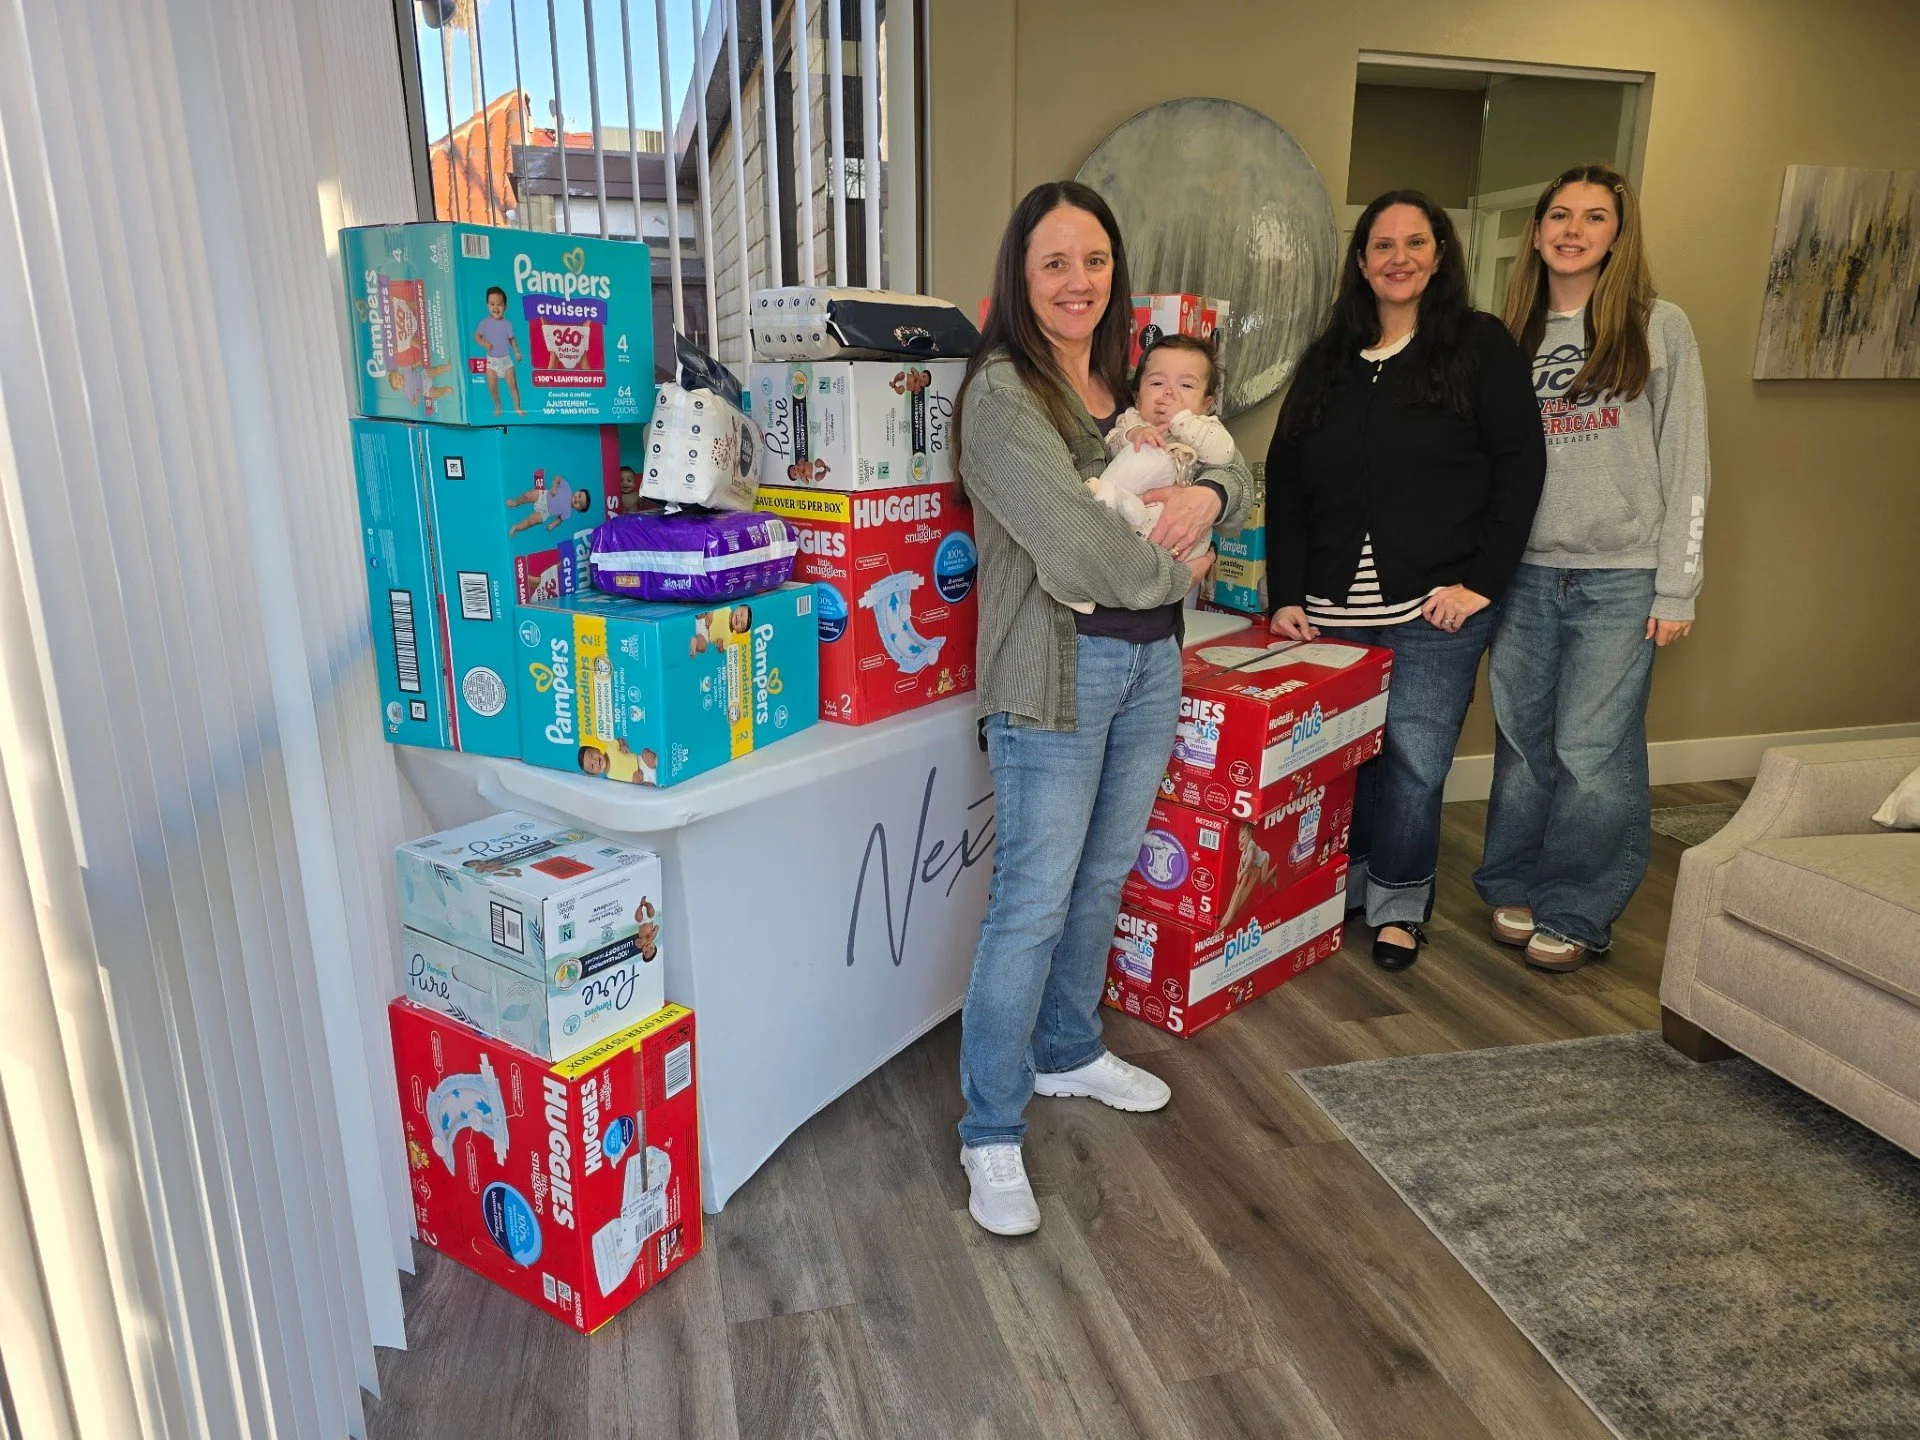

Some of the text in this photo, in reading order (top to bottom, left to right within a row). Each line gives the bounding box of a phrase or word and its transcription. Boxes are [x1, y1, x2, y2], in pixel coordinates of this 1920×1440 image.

[392, 248, 402, 263] 4
[429, 243, 437, 263] 64
[514, 254, 610, 301] Pampers
[537, 302, 598, 318] cruisers
[366, 270, 386, 378] Pampers
[382, 287, 393, 357] cruisers
[616, 334, 628, 352] 4
[618, 386, 631, 397] 64
[612, 406, 638, 414] COUCHES
[614, 398, 636, 406] DIAPERS
[1542, 398, 1577, 414] ALL
[765, 398, 789, 460] Pure
[930, 391, 953, 453] Pure
[1542, 406, 1620, 435] ERICAN
[1548, 433, 1598, 445] RLEADER
[756, 496, 773, 506] SAVE
[774, 498, 795, 509] OVER
[807, 501, 823, 511] PER
[854, 492, 941, 529] HUGGIES
[905, 529, 941, 543] snugglers
[917, 523, 928, 531] little
[791, 526, 846, 557] GIES
[1219, 537, 1247, 556] Pampers
[947, 549, 964, 560] 100%
[806, 564, 847, 578] snugglers
[617, 577, 639, 586] 3T-4T
[1243, 591, 1248, 601] 5
[581, 634, 593, 645] 2
[621, 639, 628, 652] 84
[753, 623, 774, 725] Pampers
[545, 638, 574, 745] Pampers
[580, 656, 592, 736] swaddlers
[620, 694, 625, 702] de
[824, 700, 837, 710] 144
[841, 694, 851, 713] 2
[1180, 696, 1226, 724] GIES
[1269, 710, 1294, 730] HUGGIES
[1291, 701, 1322, 752] plus
[740, 730, 748, 740] 2
[1272, 729, 1292, 743] PROMESSE
[1372, 730, 1383, 755] 5
[682, 748, 689, 762] 84
[1186, 782, 1198, 790] 156
[1231, 790, 1252, 818] 5
[468, 834, 538, 856] Pure
[1340, 825, 1349, 849] 5
[1182, 895, 1193, 903] 156
[1200, 895, 1212, 913] 5
[1117, 913, 1158, 943] GIES
[1263, 918, 1281, 931] PROMISE
[564, 930, 571, 941] N
[1194, 931, 1224, 953] HUGGIES
[1224, 917, 1262, 967] plus
[1331, 928, 1341, 951] 5
[1200, 948, 1223, 963] PROMESSE
[409, 953, 450, 1000] Pure
[427, 964, 448, 978] Pampers
[582, 965, 640, 1010] Pure
[584, 1000, 612, 1017] Pampers
[659, 1009, 679, 1021] SAVE
[1166, 1004, 1184, 1032] 5
[625, 1019, 655, 1039] OVER
[593, 1044, 614, 1056] PER
[581, 1078, 602, 1177] HUGGIES
[543, 1076, 575, 1230] HUGGIES
[530, 1151, 544, 1215] snugglers
[518, 1214, 527, 1242] 100%
[422, 1229, 437, 1246] 2
